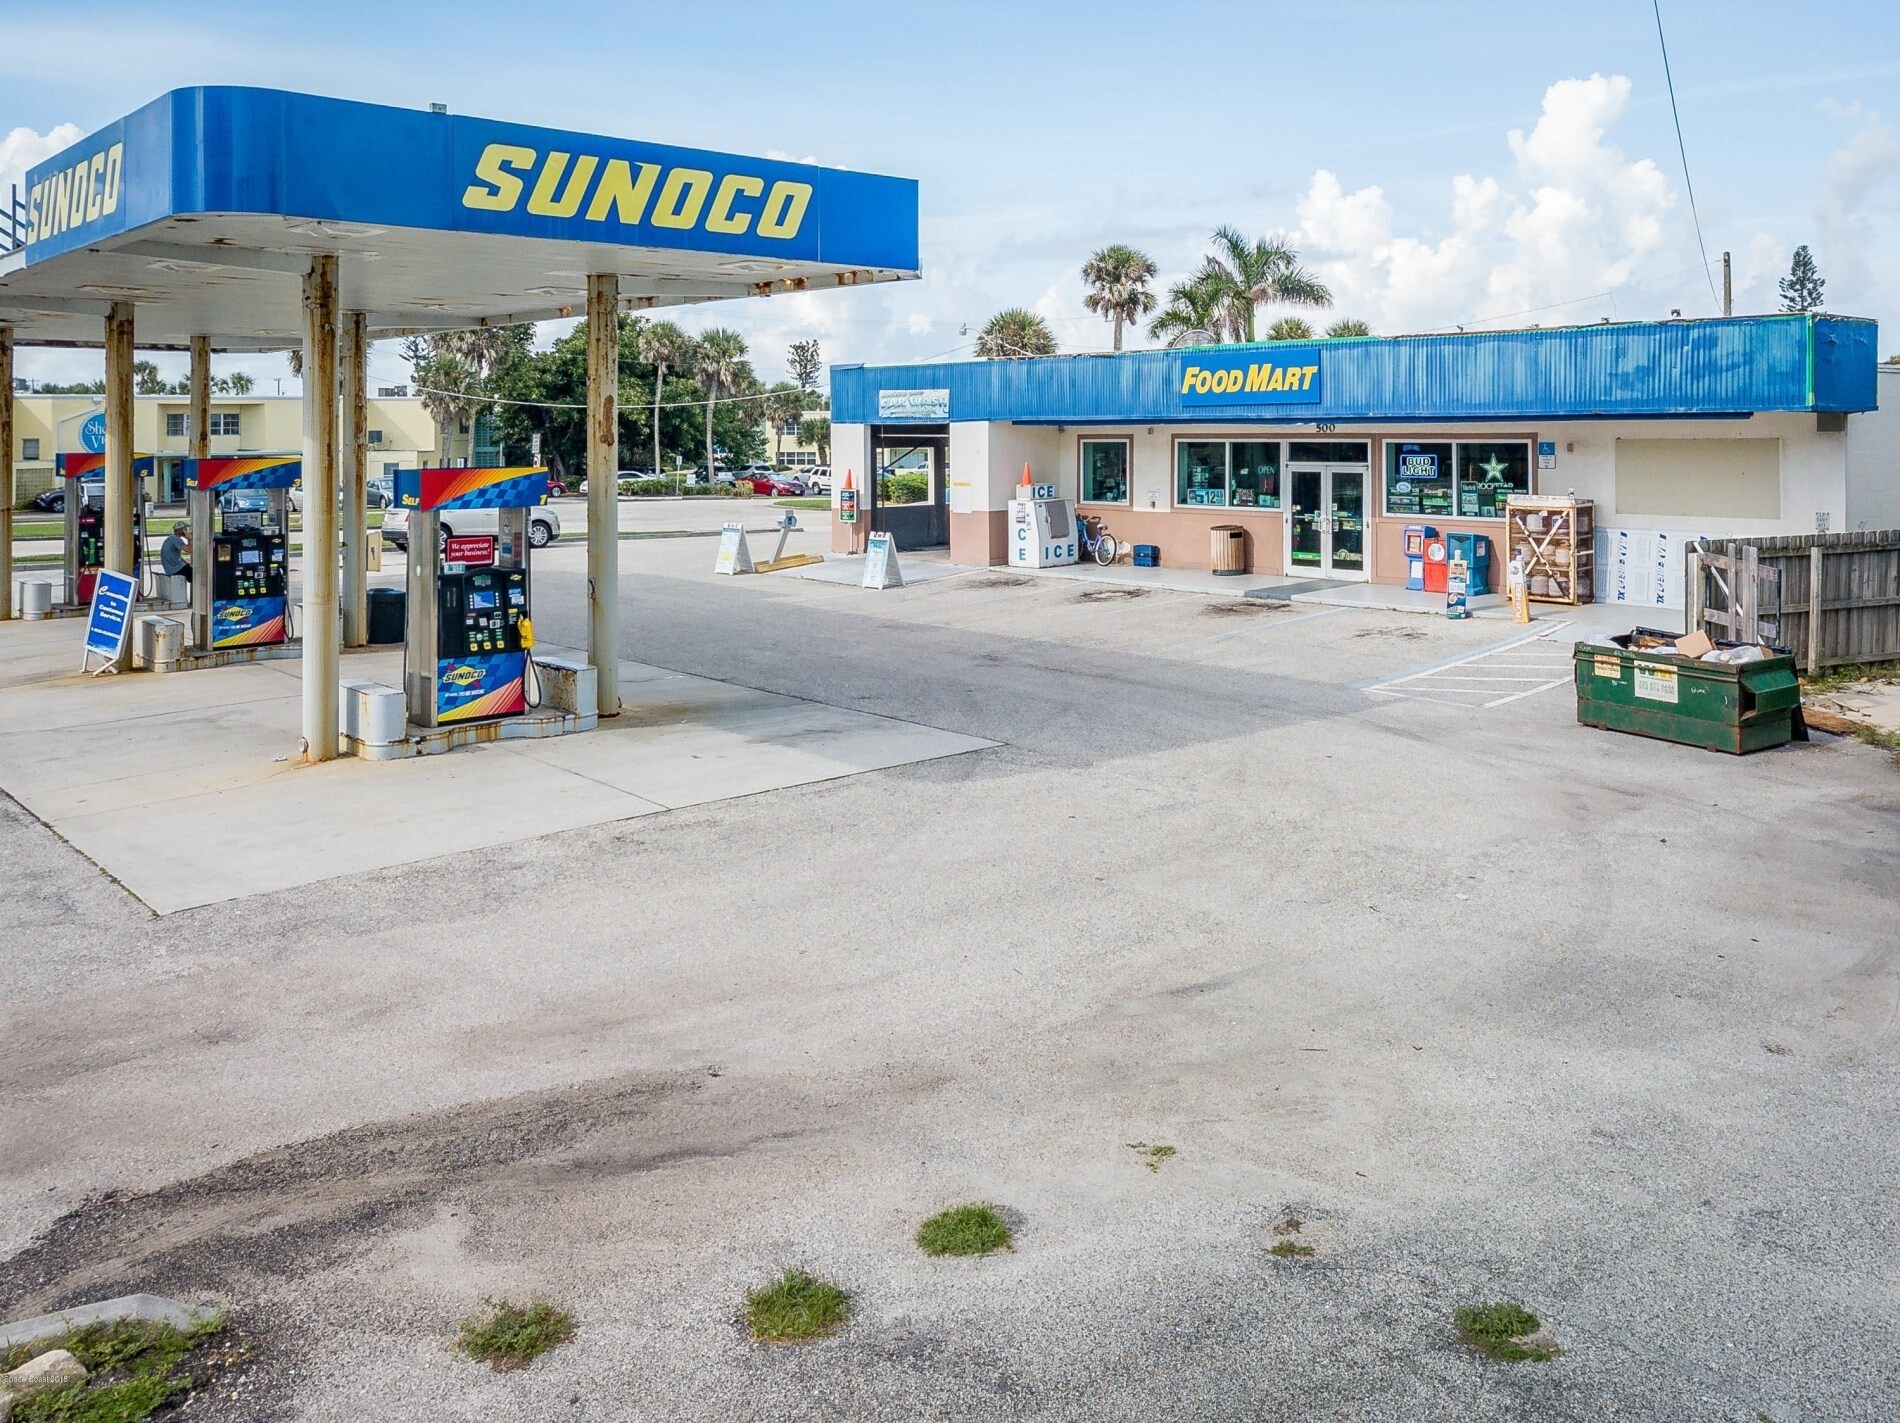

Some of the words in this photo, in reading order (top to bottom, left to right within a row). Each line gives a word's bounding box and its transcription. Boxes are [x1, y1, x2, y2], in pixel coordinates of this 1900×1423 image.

[27, 141, 123, 246] SUNOCO
[462, 143, 813, 239] SUNOCO
[1181, 367, 1244, 394] FOOD
[1244, 363, 1319, 392] MART
[1315, 423, 1336, 433] 500
[1406, 456, 1432, 467] BUD
[140, 469, 149, 477] 5
[1257, 465, 1275, 475] OPEN
[1402, 466, 1436, 476] LIGHT
[1032, 485, 1054, 499] ICE
[401, 493, 420, 506] SELF
[539, 494, 548, 506] 1
[461, 541, 490, 551] appreciate
[1045, 543, 1075, 560] ICE
[464, 548, 490, 557] business!
[218, 609, 252, 619] SUNOCO
[443, 669, 486, 682] SUNOCO
